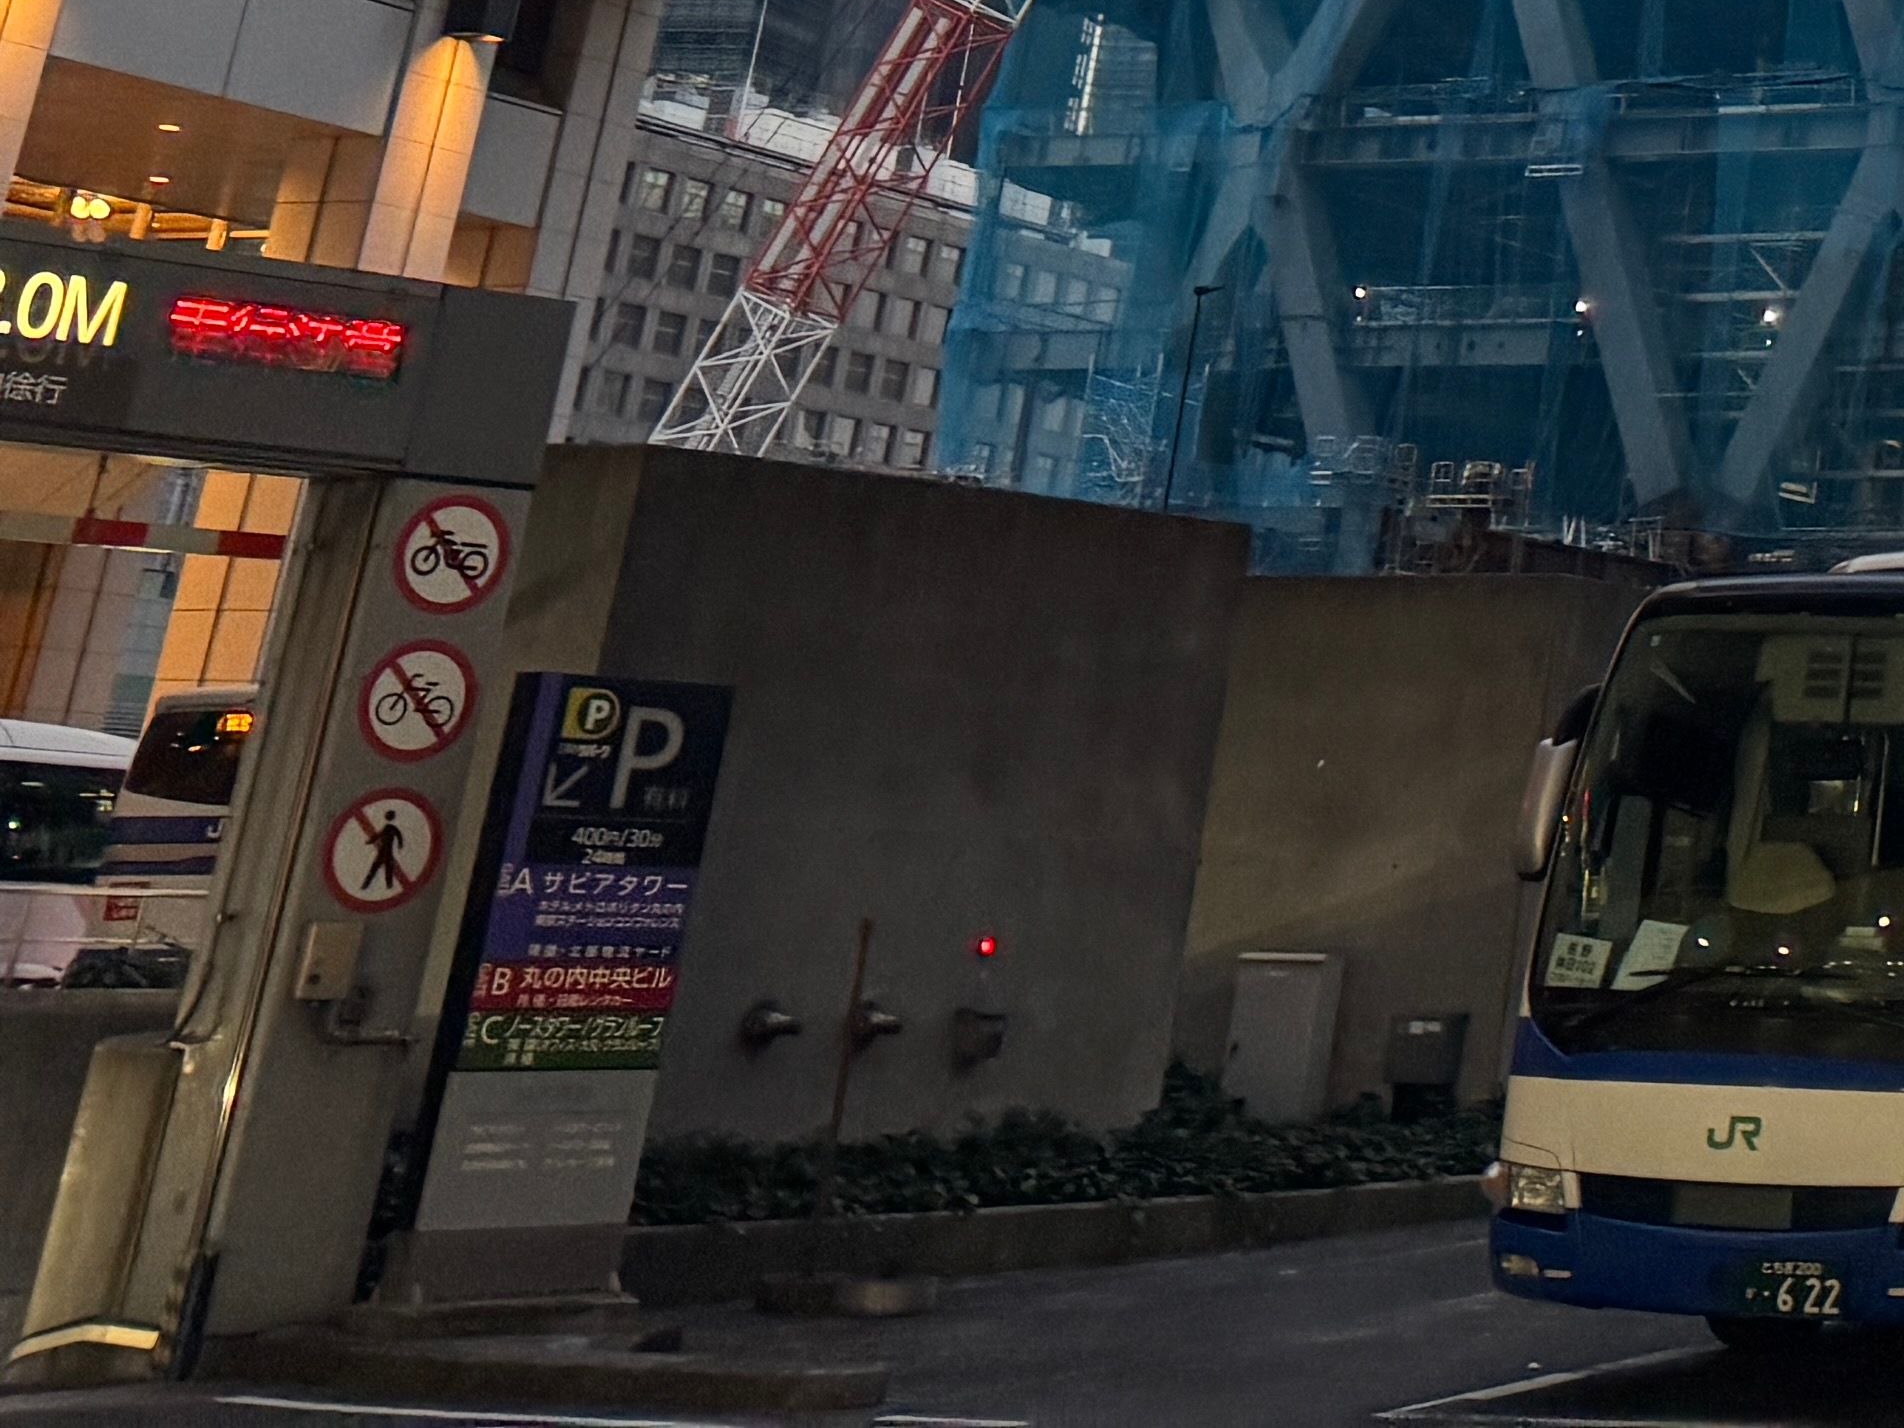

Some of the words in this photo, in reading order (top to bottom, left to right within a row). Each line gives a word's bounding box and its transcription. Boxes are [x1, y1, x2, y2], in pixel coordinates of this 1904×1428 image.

[0, 270, 128, 346] .0M
[0, 371, 68, 405] 徐行
[609, 705, 685, 809] P
[510, 867, 534, 895] A
[544, 872, 688, 895] サピアタワー
[491, 967, 512, 995] B
[518, 966, 673, 989] 丸の内中央ビル
[480, 1016, 505, 1044] C
[1707, 1116, 1762, 1151] JR
